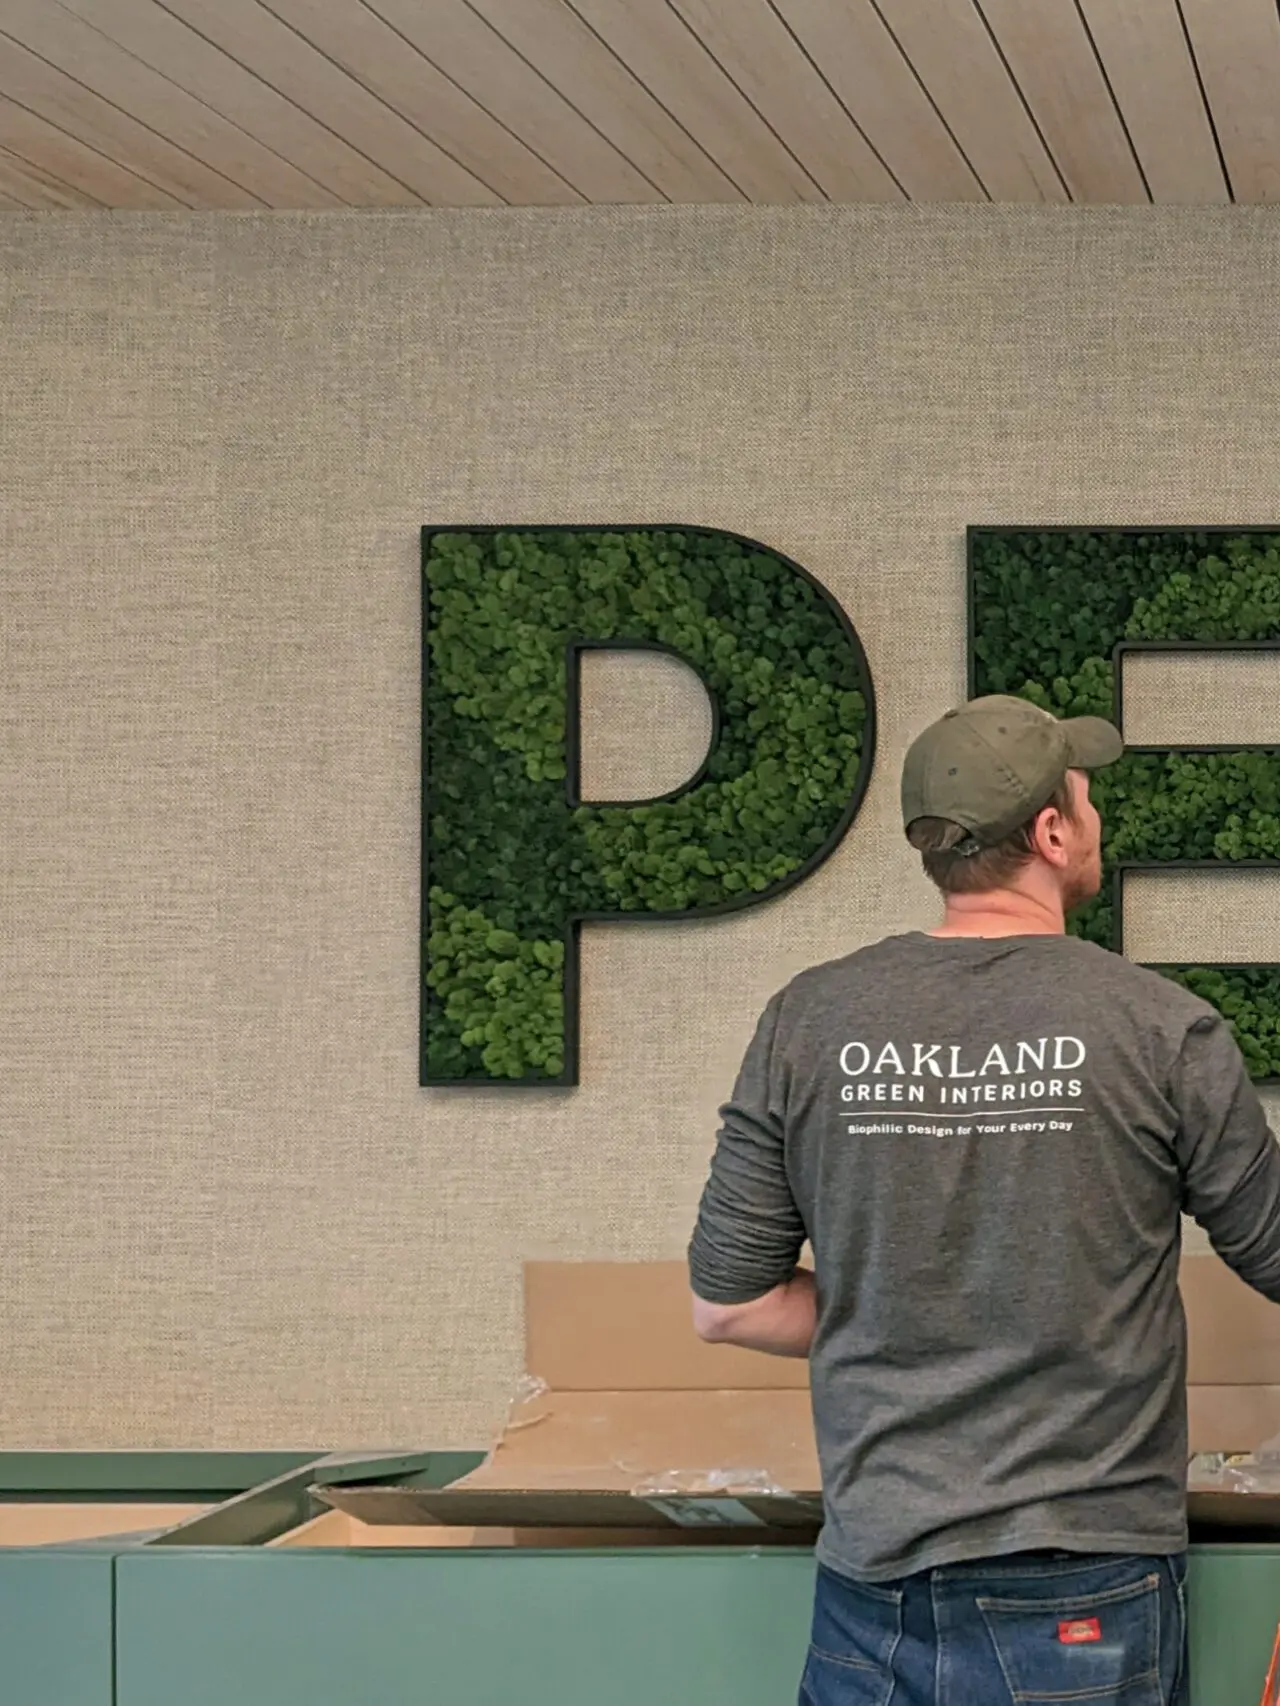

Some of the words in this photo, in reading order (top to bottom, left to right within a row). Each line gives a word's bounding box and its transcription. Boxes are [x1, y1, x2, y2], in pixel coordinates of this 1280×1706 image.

[839, 1036, 1086, 1078] OAKLAND
[841, 1083, 925, 1102] GREEN
[940, 1079, 1082, 1104] INTERIORS
[847, 1123, 903, 1135] Biophilic
[907, 1124, 954, 1138] Design
[957, 1126, 973, 1135] for
[975, 1124, 1007, 1133] Your
[1009, 1122, 1046, 1132] Every
[1049, 1120, 1074, 1132] Day
